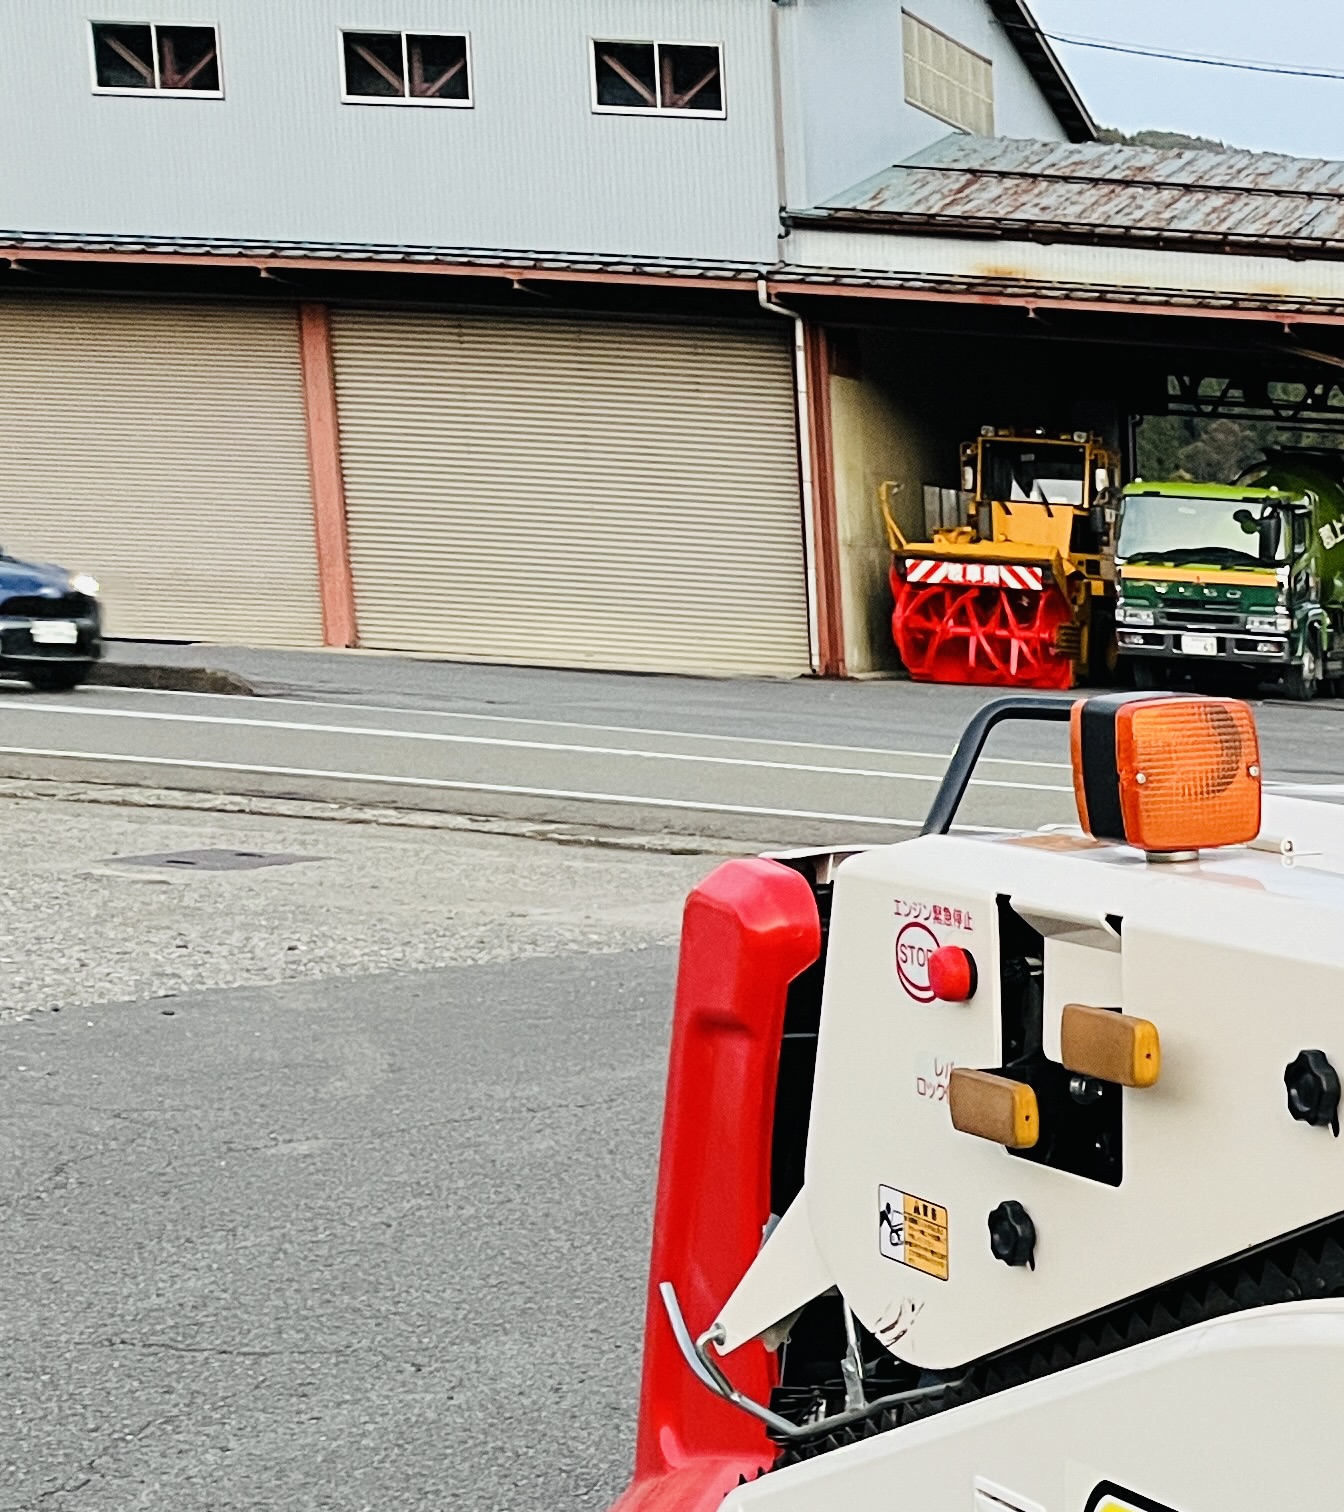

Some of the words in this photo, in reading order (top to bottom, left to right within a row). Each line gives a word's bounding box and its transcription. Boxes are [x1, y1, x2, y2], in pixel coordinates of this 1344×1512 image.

[893, 899, 974, 931] エンジン緊急停止
[916, 1076, 950, 1104] ロック
